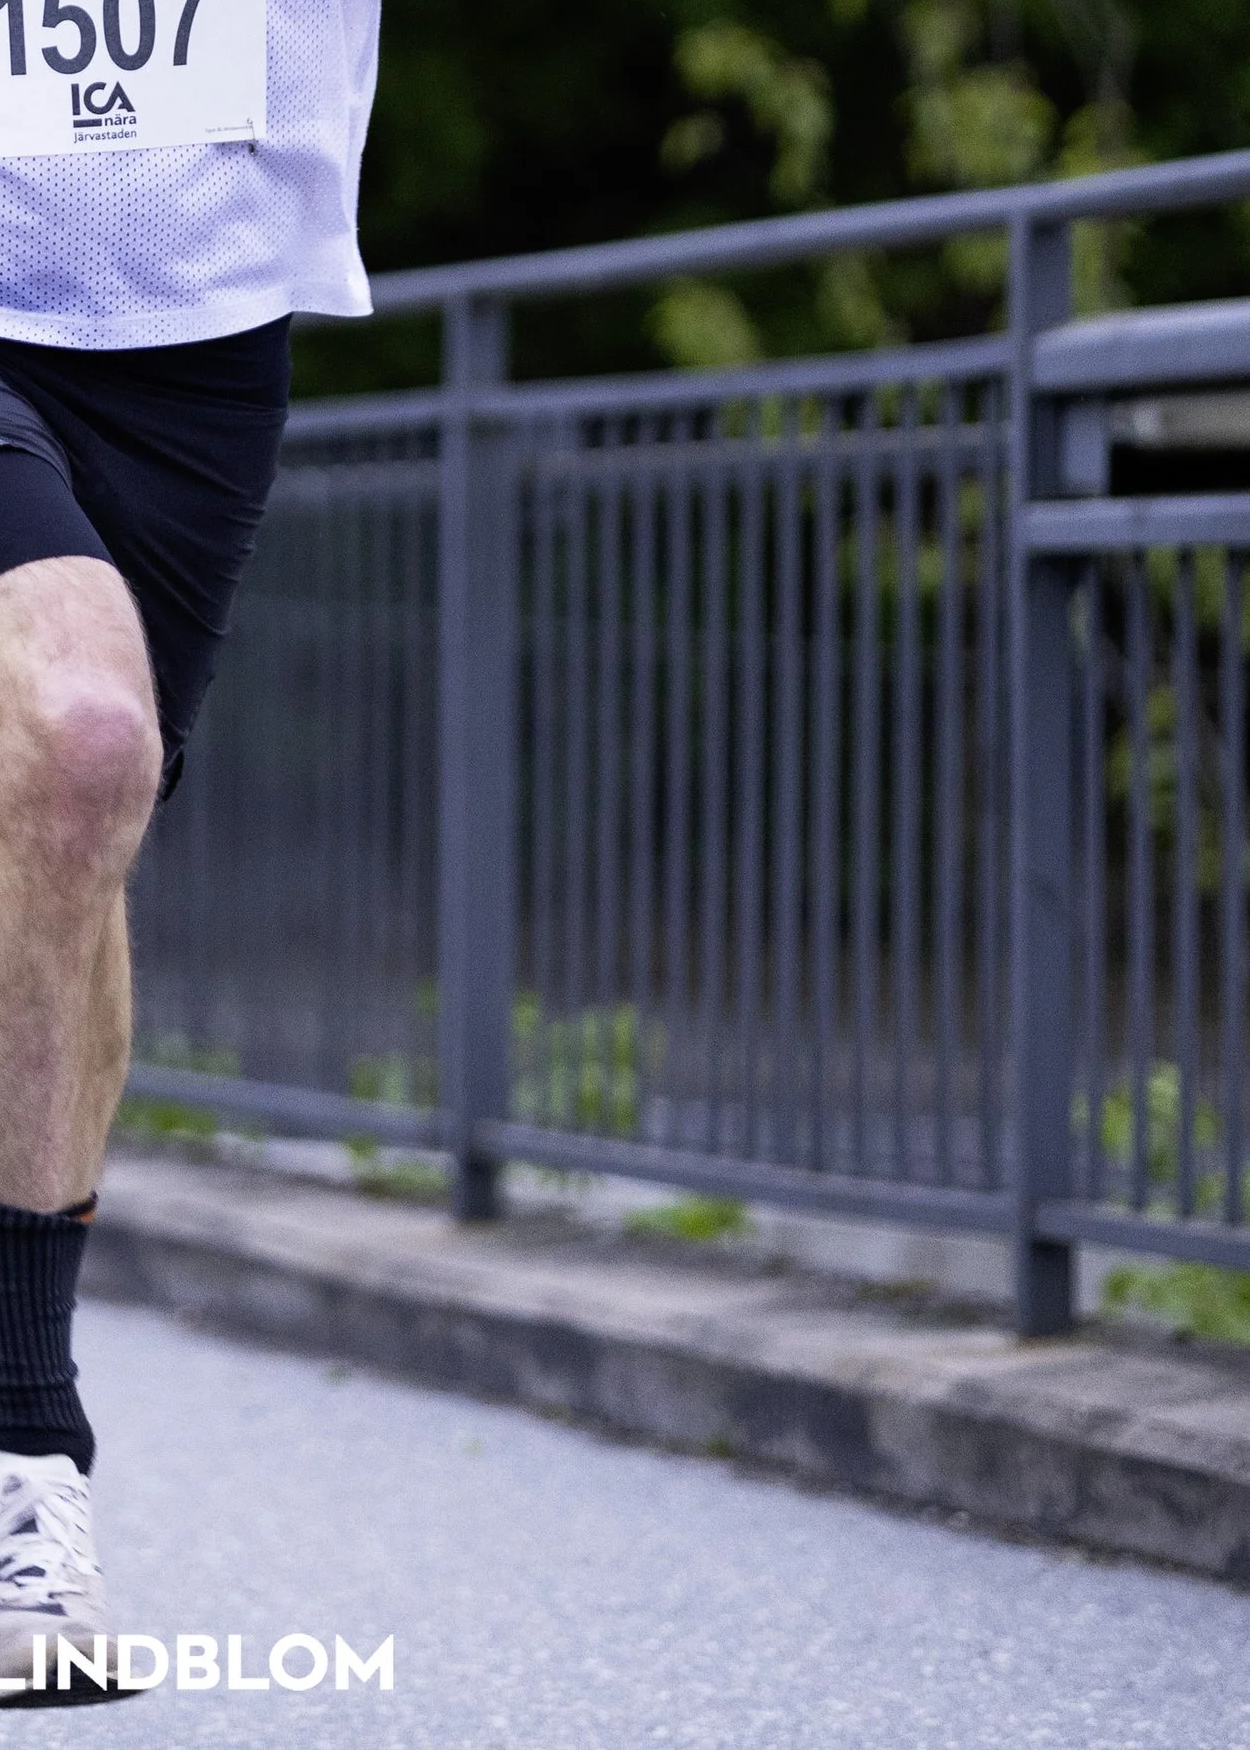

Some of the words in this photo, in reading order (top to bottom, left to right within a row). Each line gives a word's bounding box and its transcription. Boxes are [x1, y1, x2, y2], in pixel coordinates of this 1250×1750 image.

[71, 81, 136, 116] ICA
[104, 113, 137, 127] nära
[73, 129, 137, 144] Järvastaden
